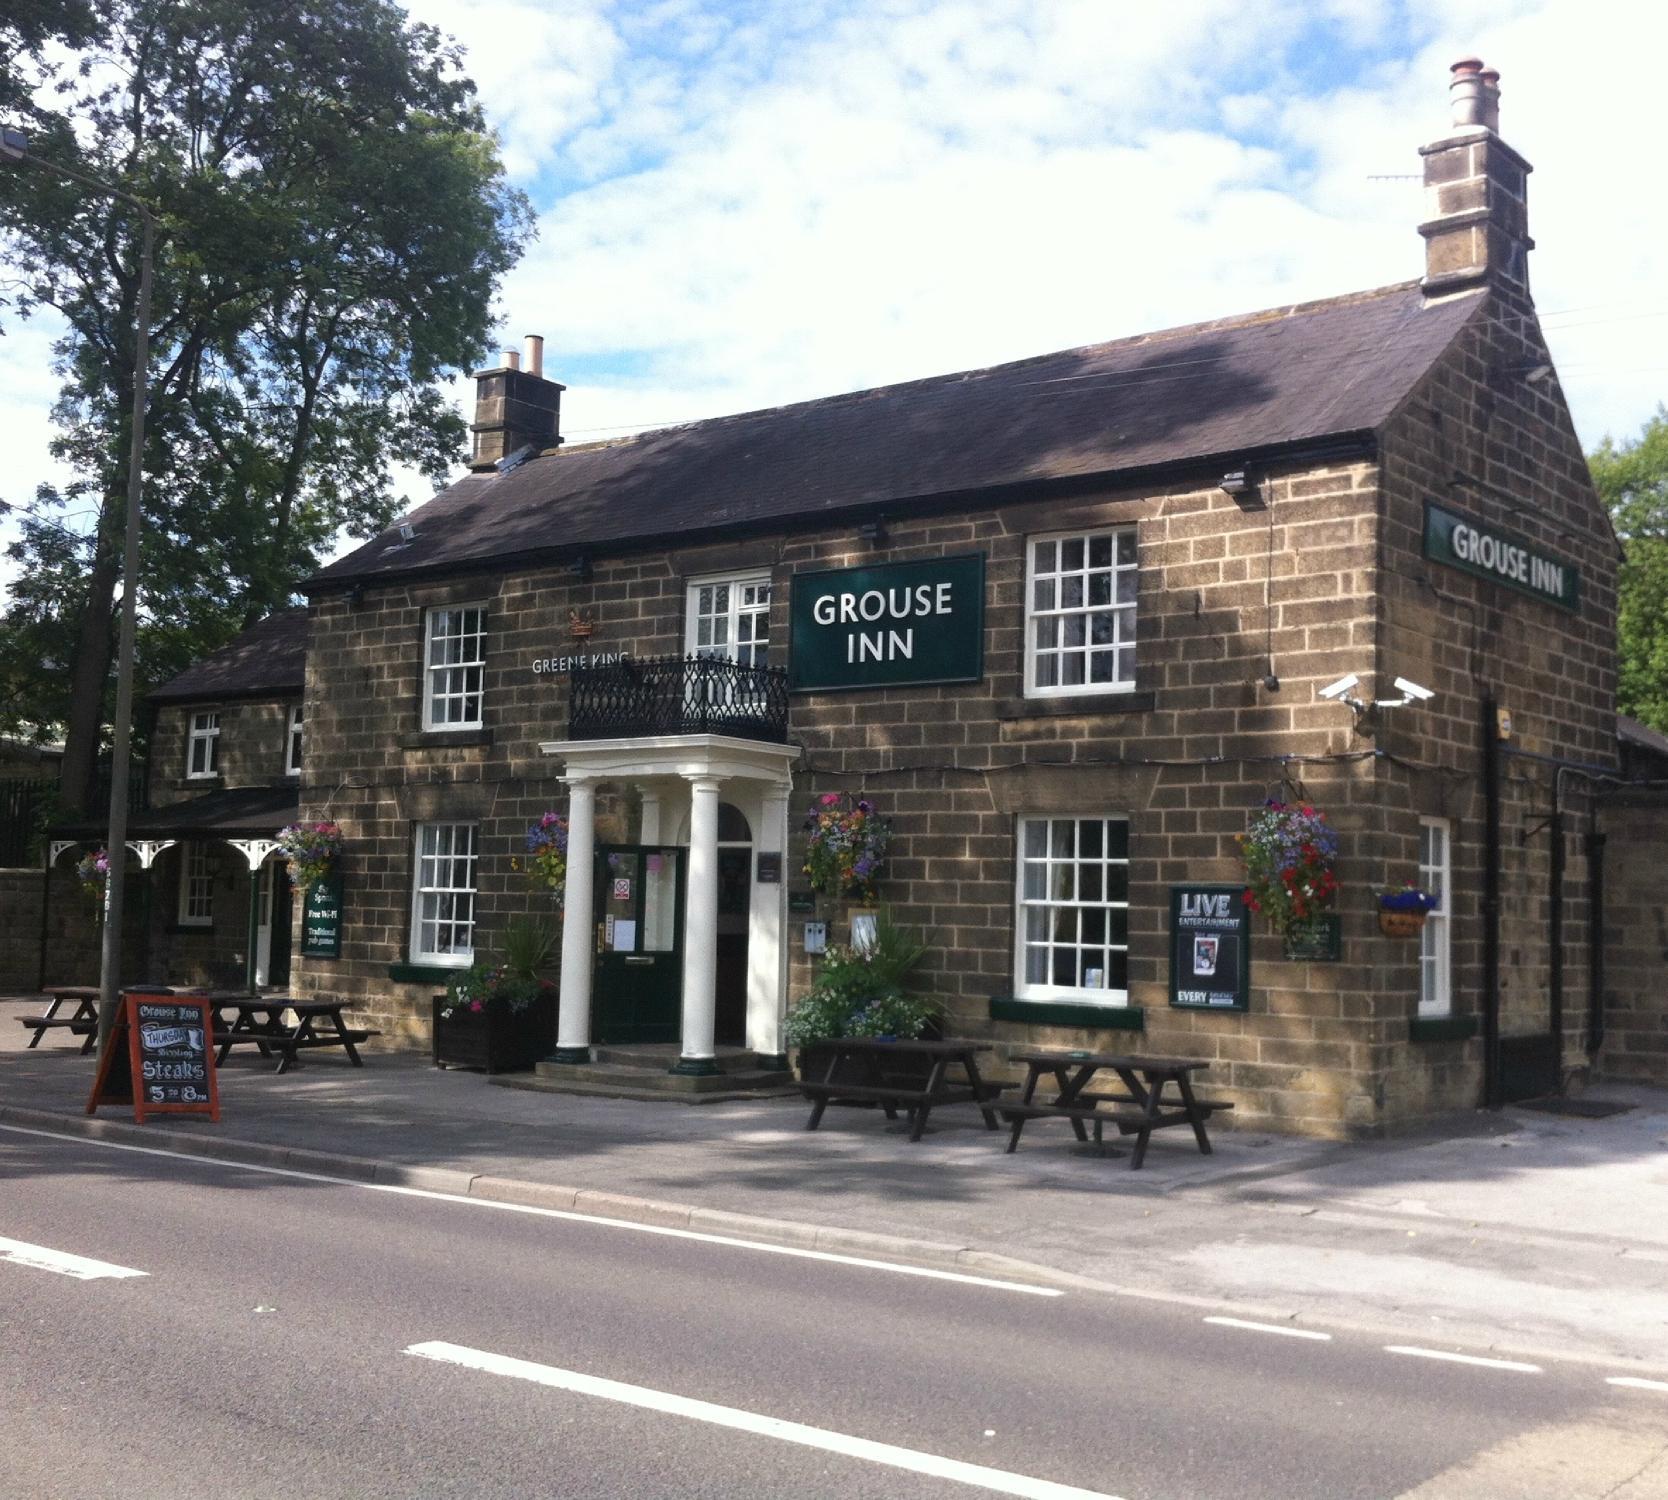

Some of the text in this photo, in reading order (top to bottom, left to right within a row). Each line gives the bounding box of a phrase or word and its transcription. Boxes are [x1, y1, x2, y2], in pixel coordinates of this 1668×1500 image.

[1453, 524, 1562, 597] GROUSE INN
[813, 583, 952, 625] GROUSE
[847, 628, 913, 663] INN
[532, 655, 586, 673] GREENE
[1180, 893, 1231, 917] LIVE
[1179, 917, 1240, 928] ENTERTAINMENT
[1178, 991, 1206, 1002] EVERY
[140, 1005, 177, 1018] Grouse
[143, 1060, 205, 1080] Steaks
[150, 1085, 165, 1102] 5
